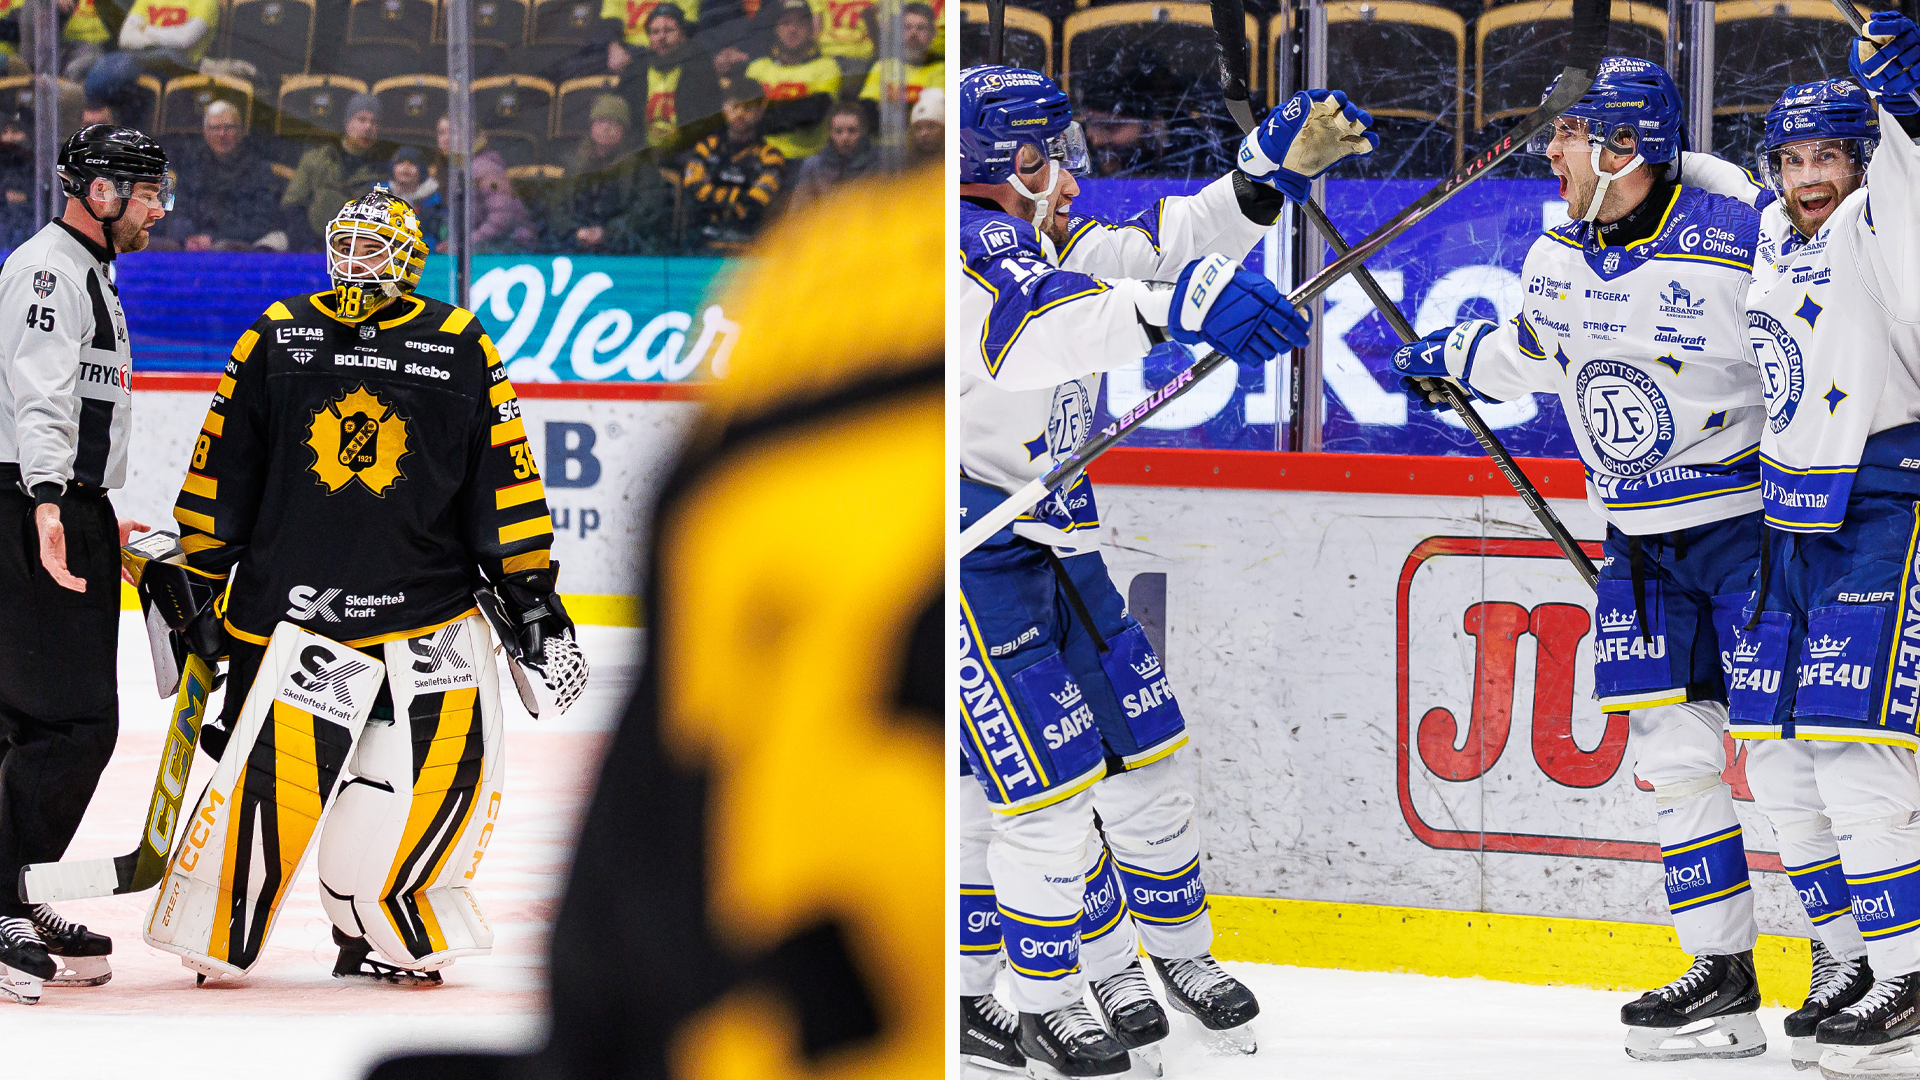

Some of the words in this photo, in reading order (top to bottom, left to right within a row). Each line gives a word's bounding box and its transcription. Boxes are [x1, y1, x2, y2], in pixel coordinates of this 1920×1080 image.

[1445, 136, 1511, 192] FLYLITE
[1658, 212, 1687, 243] TEGERA
[1705, 227, 1736, 242] Clas
[987, 231, 1012, 248] NS
[1702, 240, 1749, 259] Ohlson
[34, 279, 54, 289] EDF
[26, 303, 56, 333] 45
[1659, 304, 1705, 317] LEKSANDS
[292, 327, 324, 337] LEAB
[1654, 332, 1707, 346] dalakraft
[405, 340, 456, 355] engcon
[334, 354, 398, 372] BOLIDEN
[404, 362, 451, 381] skebo
[1118, 367, 1194, 432] BAUER
[1586, 361, 1673, 441] IDROTTSFÖRENING
[357, 455, 373, 463] 1921
[1602, 447, 1665, 476] ISHOCKEY
[345, 591, 406, 607] Skellefteå
[1837, 591, 1895, 604] BAUER
[344, 607, 377, 618] Kraft
[989, 626, 1041, 657] BAUER
[414, 675, 452, 689] Skellefteå
[452, 673, 473, 685] Kraft
[282, 687, 327, 712] Skellefteå
[328, 706, 352, 722] Kraft
[148, 671, 207, 857] CCM
[179, 787, 226, 873] CCM
[463, 790, 502, 880] CCM
[1669, 878, 1706, 894] ELECTRO
[1685, 990, 1719, 1014] BAUER
[1885, 1005, 1916, 1030] BAUER
[966, 1028, 1005, 1051] BAUER
